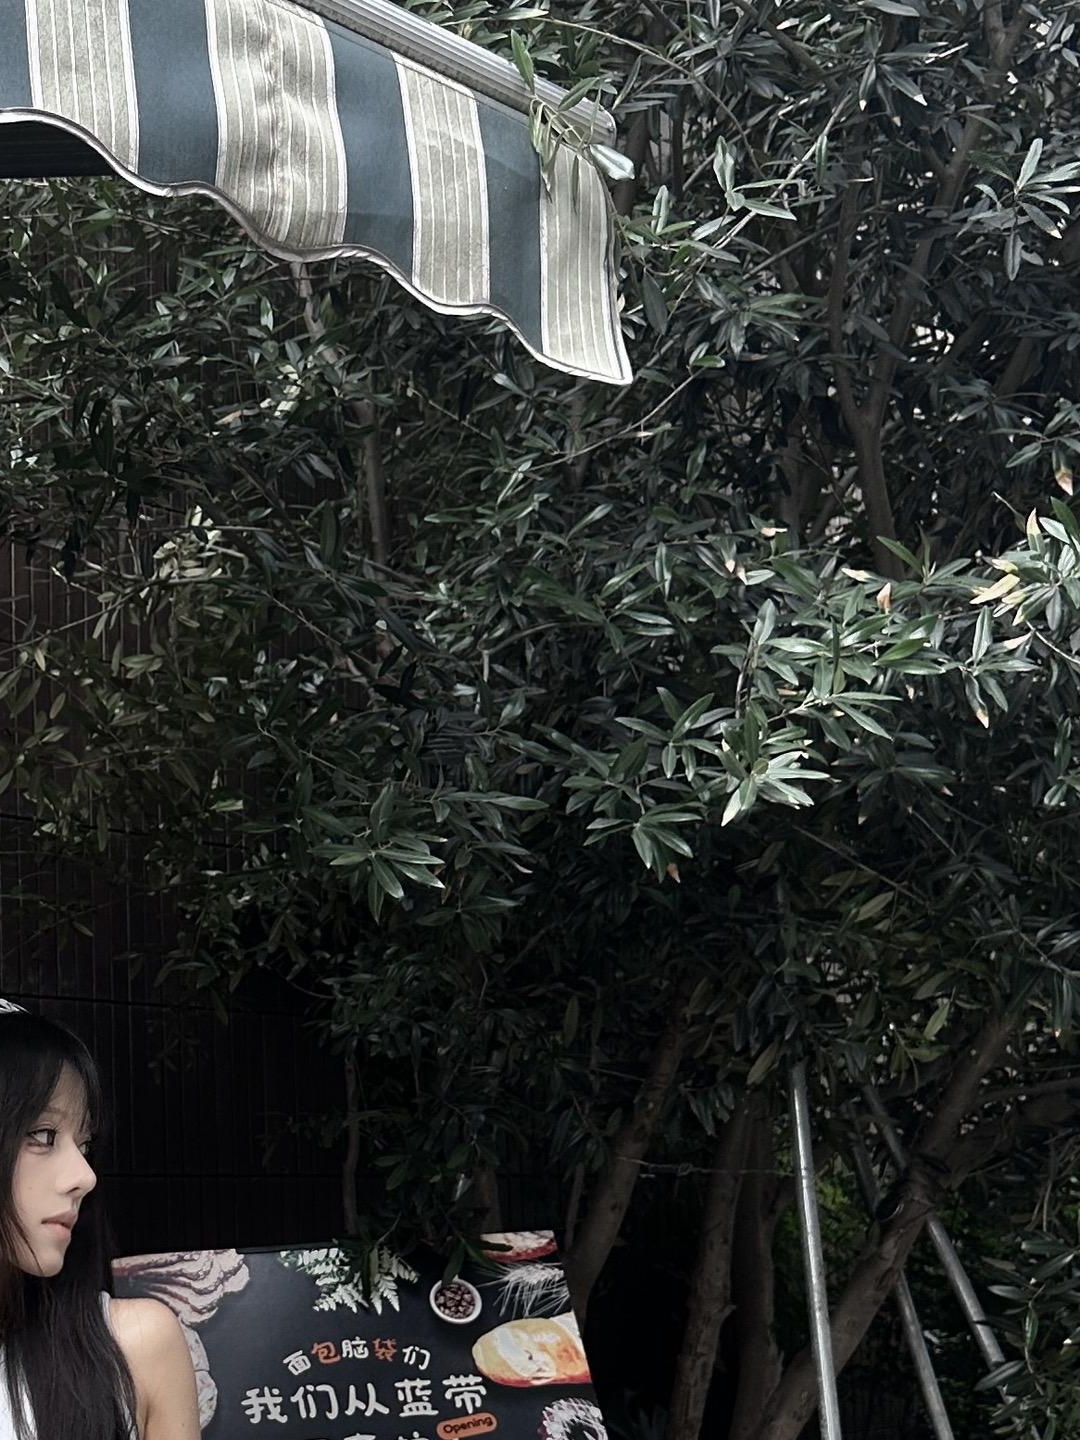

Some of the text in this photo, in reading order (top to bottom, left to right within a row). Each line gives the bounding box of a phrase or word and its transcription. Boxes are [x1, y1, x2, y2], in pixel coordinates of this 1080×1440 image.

[283, 1337, 431, 1376] 面包脑袋们
[241, 1374, 487, 1424] 我们从蓝带
[443, 1415, 494, 1434] Opening
